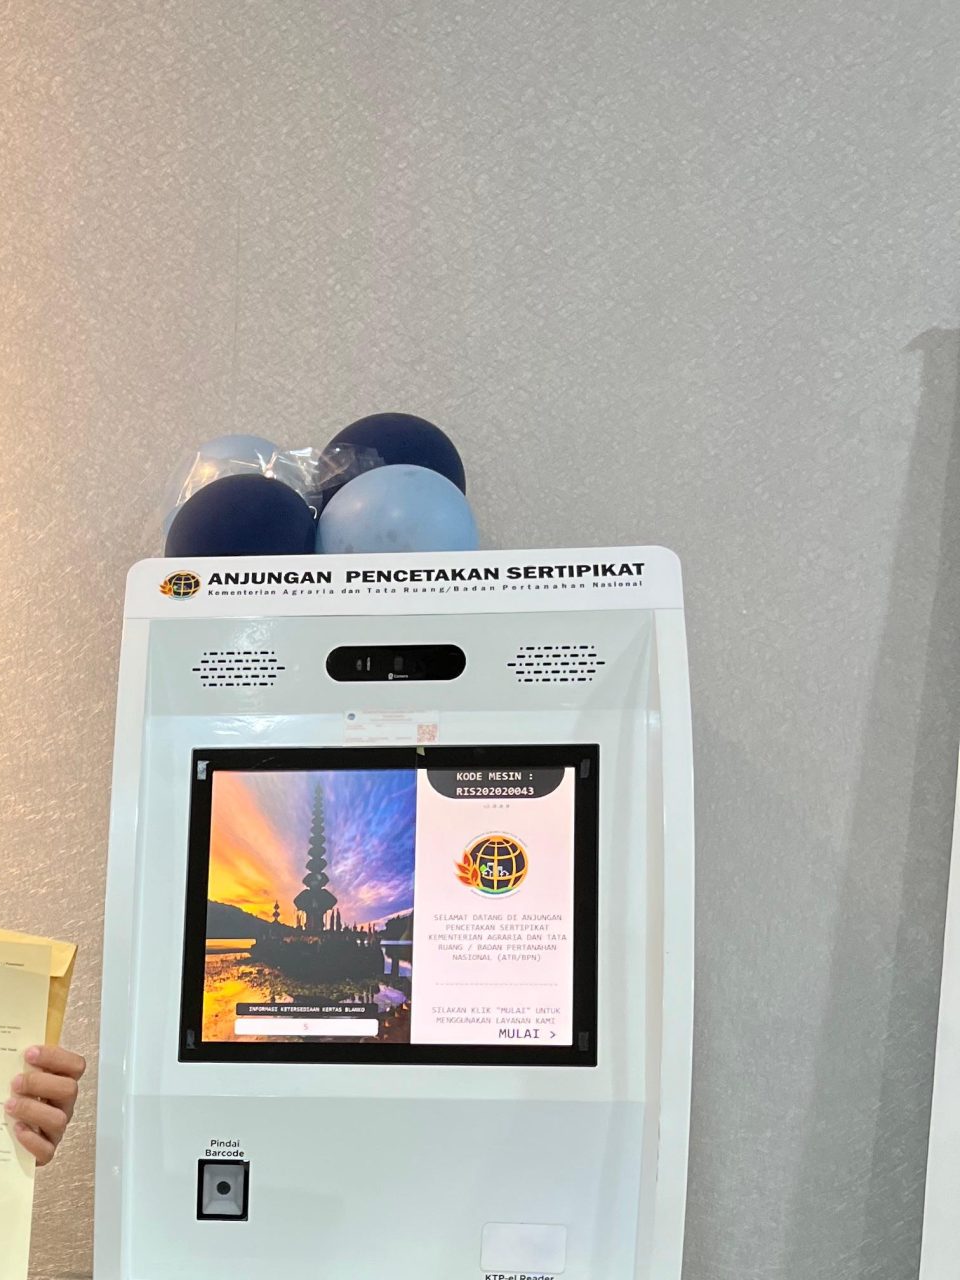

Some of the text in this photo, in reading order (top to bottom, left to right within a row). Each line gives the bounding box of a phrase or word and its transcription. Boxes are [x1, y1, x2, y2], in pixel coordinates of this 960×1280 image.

[208, 563, 645, 585] ANJUNGAN PENCETAKAN SERTIPIKAT
[282, 588, 334, 596] Agraria
[403, 585, 495, 593] Ruang/Badan
[502, 582, 585, 590] Pertanahan
[592, 580, 642, 588] Nasional
[456, 772, 482, 781] KODE
[489, 772, 522, 781] MESIN
[456, 786, 534, 796] RIS202020043
[497, 953, 541, 962] (ATR/BPN)
[499, 1029, 540, 1039] MULAI
[210, 1139, 240, 1148] Pindai
[205, 1149, 245, 1158] Barcode
